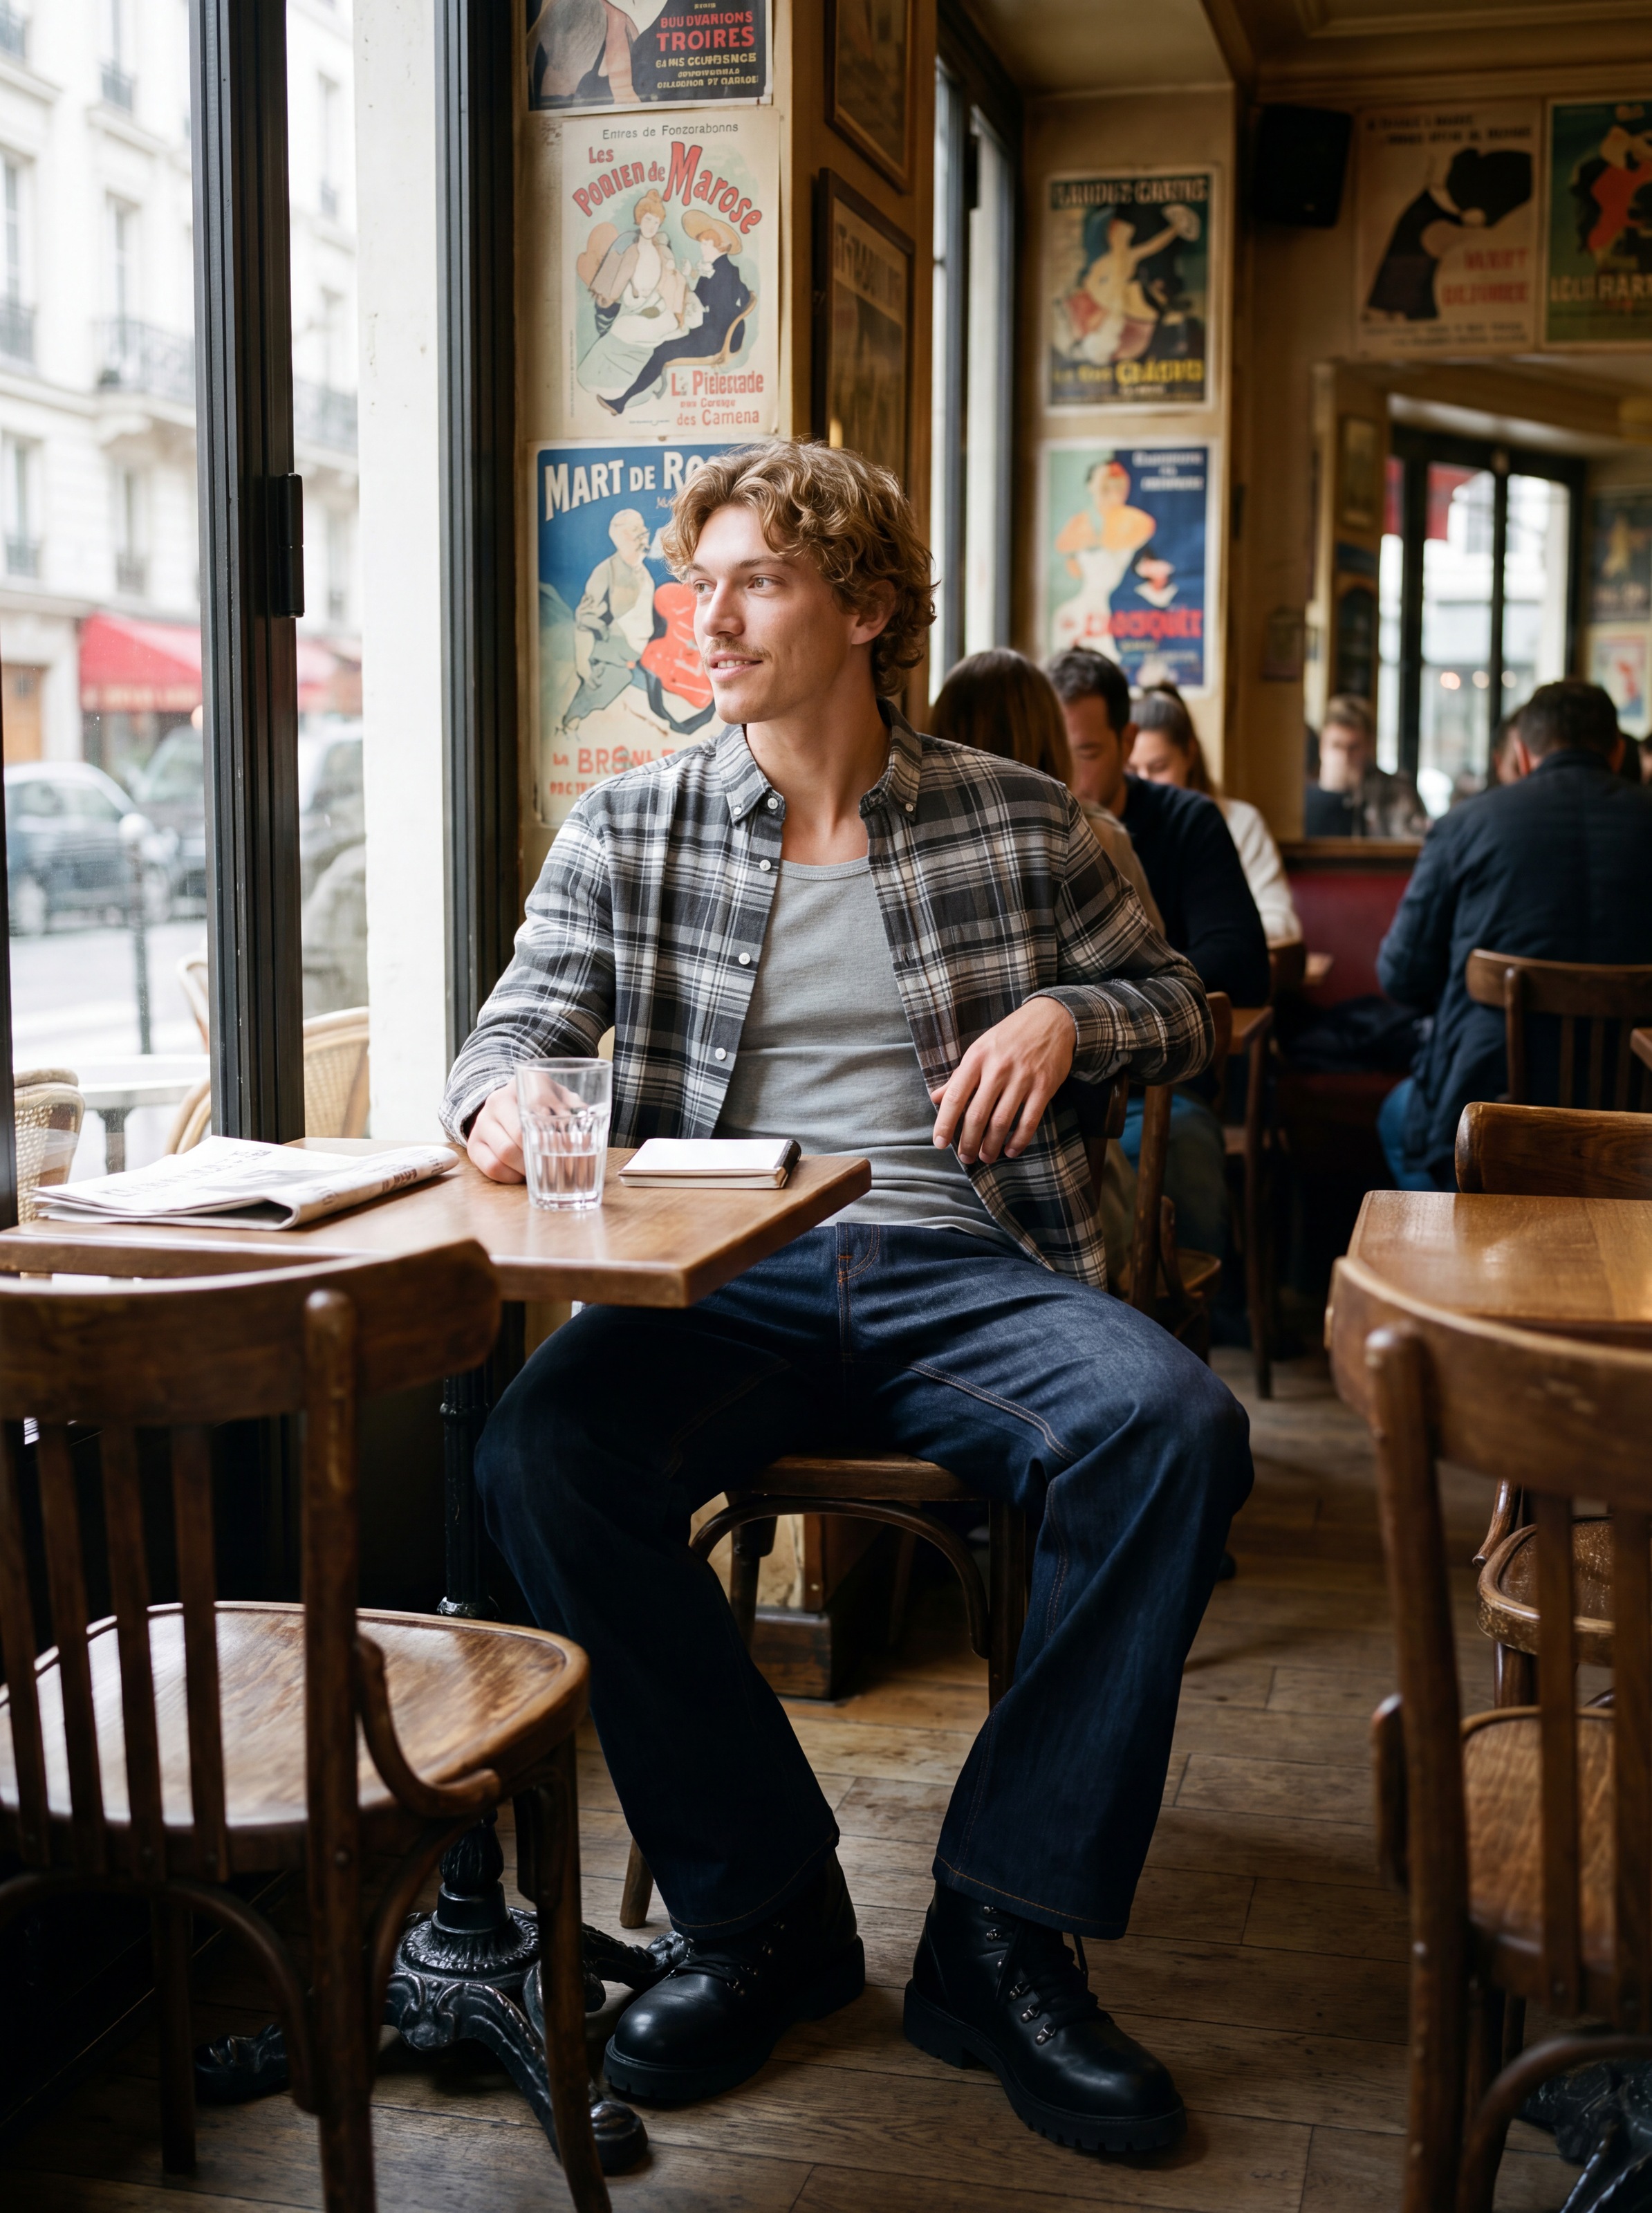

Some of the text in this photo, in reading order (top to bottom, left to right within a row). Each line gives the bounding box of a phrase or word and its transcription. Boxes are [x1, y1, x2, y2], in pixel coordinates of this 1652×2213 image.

[656, 26, 755, 52] TROIRES
[643, 127, 656, 137] de
[588, 146, 614, 164] Les
[648, 161, 665, 182] de
[662, 141, 762, 234] Marose
[677, 413, 696, 426] des
[544, 459, 624, 521] MART
[629, 465, 656, 492] DE
